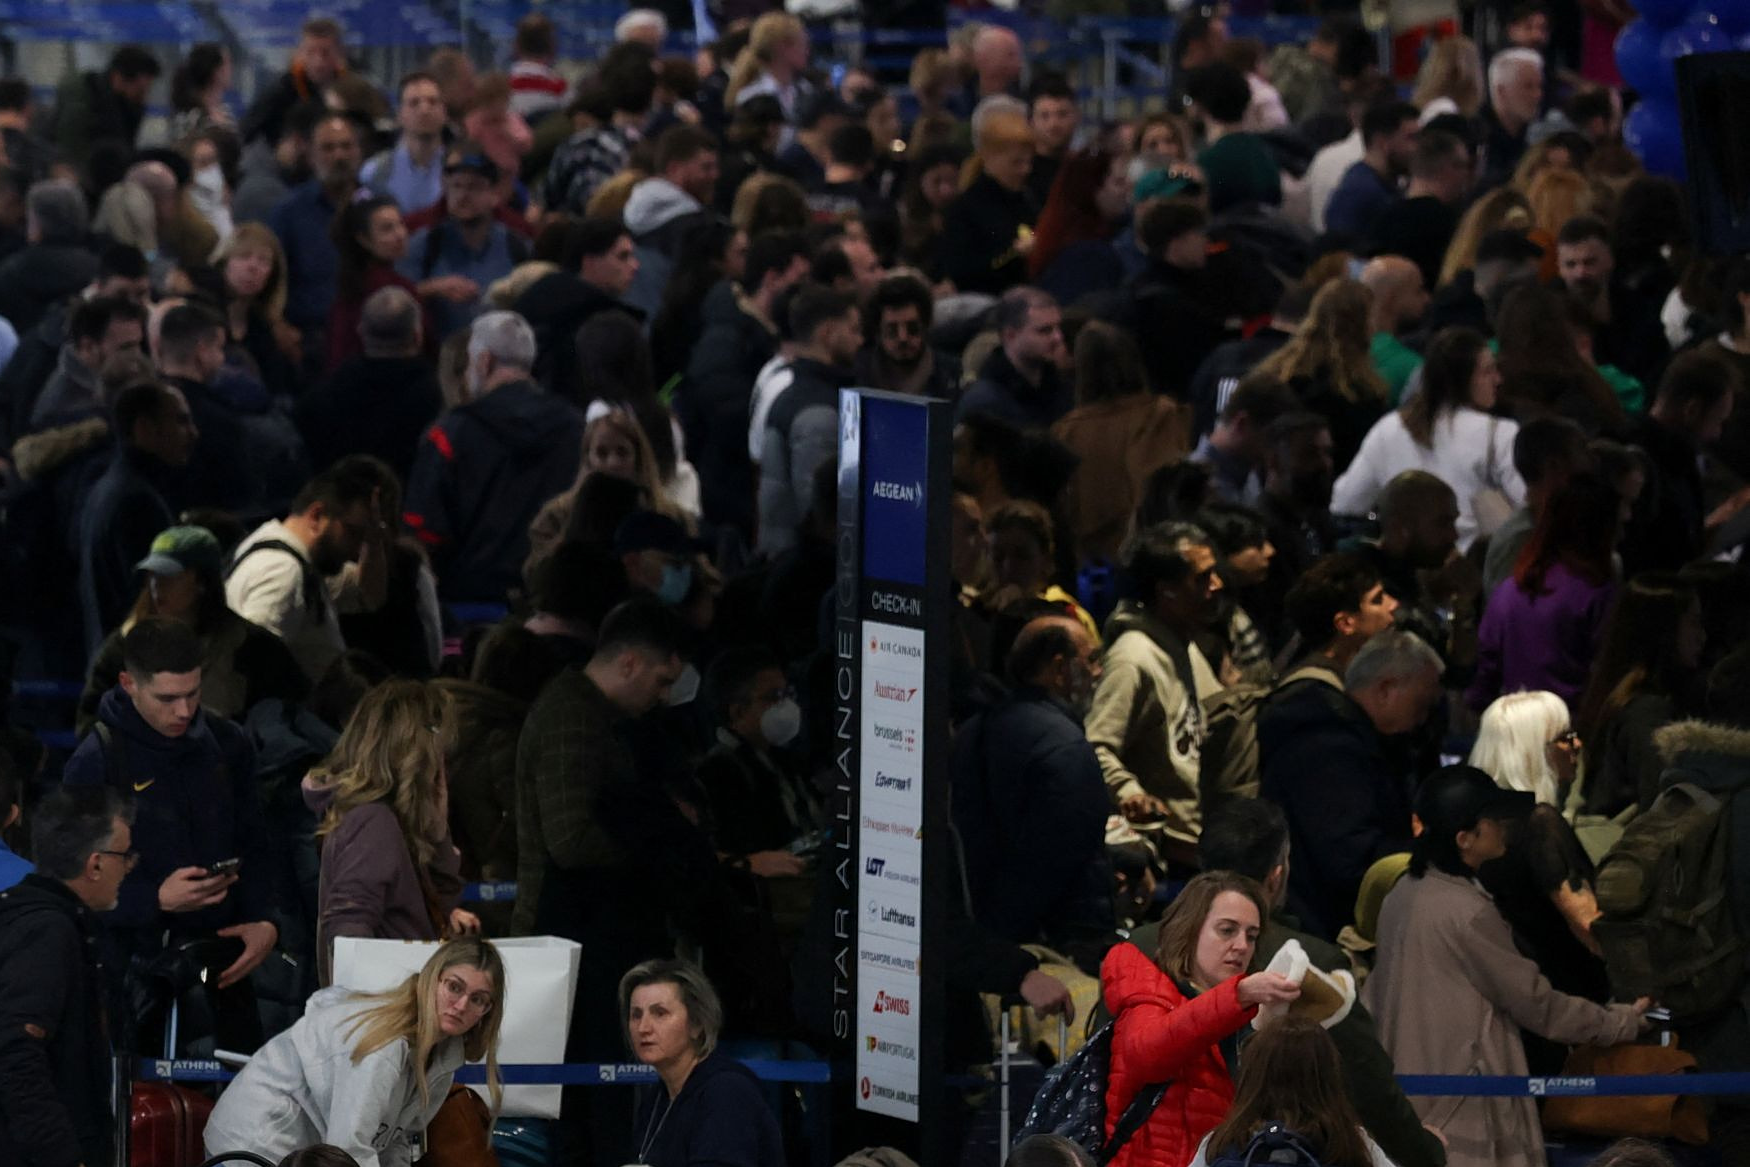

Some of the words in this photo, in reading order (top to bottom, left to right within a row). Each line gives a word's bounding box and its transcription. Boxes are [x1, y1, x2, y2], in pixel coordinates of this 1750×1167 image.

[872, 480, 915, 502] AEGEAN
[871, 590, 921, 617] CHECK-IN
[879, 641, 891, 653] AIR
[892, 643, 921, 658] CANADA
[874, 723, 903, 742] brussels
[835, 629, 854, 891] ALLIANCE
[866, 856, 885, 877] LOT
[881, 906, 915, 927] Lufthansa
[834, 908, 851, 1040] STAR
[885, 994, 910, 1016] SWISS
[173, 1060, 221, 1071] ATHENS
[872, 1084, 895, 1100] TURKISH
[1546, 1077, 1595, 1088] ATHENS
